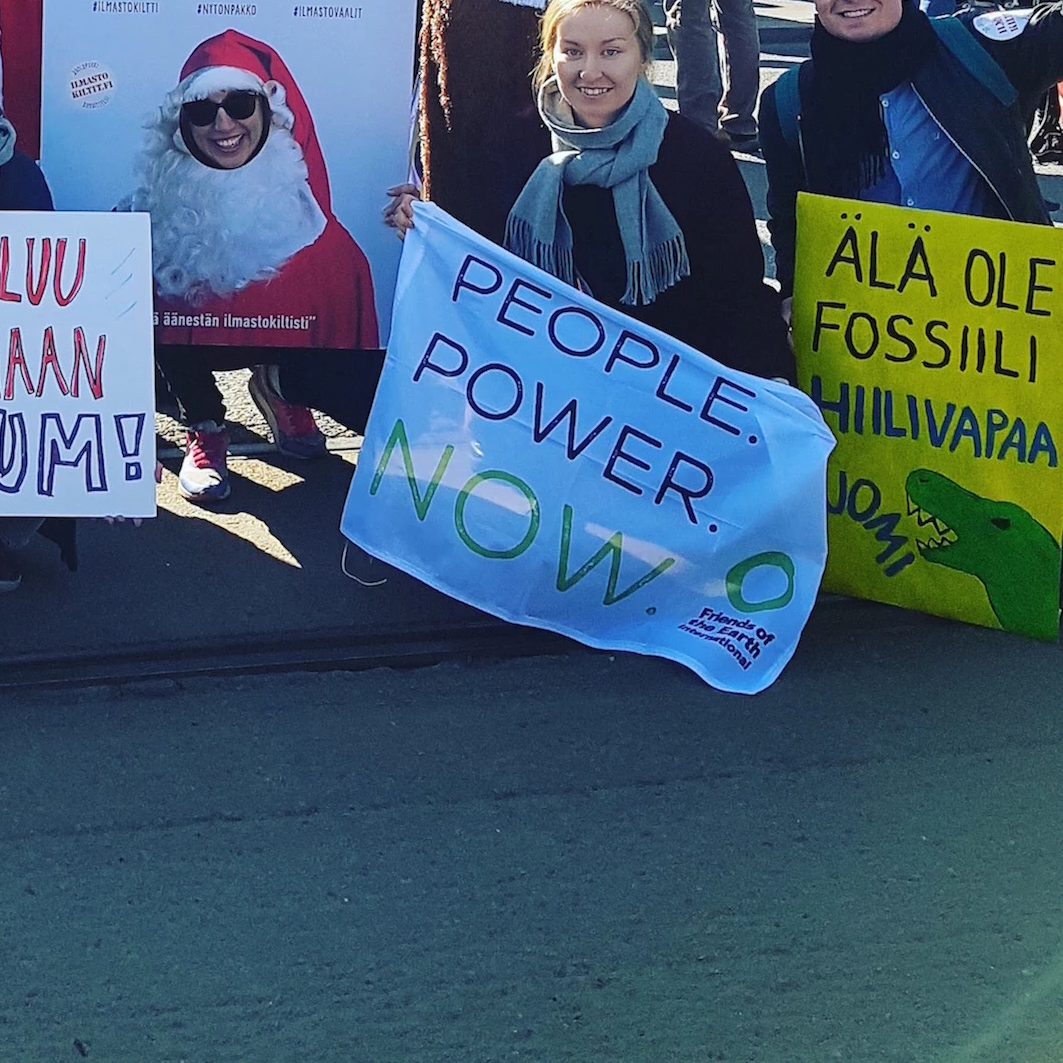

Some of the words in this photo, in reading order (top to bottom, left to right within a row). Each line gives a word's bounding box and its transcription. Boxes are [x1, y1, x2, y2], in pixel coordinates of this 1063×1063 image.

[197, 3, 257, 16] #NYTONPAKKO
[293, 5, 363, 19] #ILMASTOVAALIT
[70, 72, 109, 89] ILMASTO
[826, 212, 937, 298] ÄLÄ
[964, 248, 1056, 316] OLE
[163, 312, 220, 328] äänestän
[452, 254, 758, 444] PEOPLE.
[811, 302, 1036, 383] FOSSIILI
[413, 332, 718, 532] POWER.
[810, 376, 1058, 467] HIILIVAPAA
[369, 418, 675, 615] NOW.
[827, 471, 915, 577] UOMI
[688, 619, 716, 632] the
[717, 626, 761, 659] Earth
[698, 607, 756, 631] Friends
[756, 627, 775, 646] of
